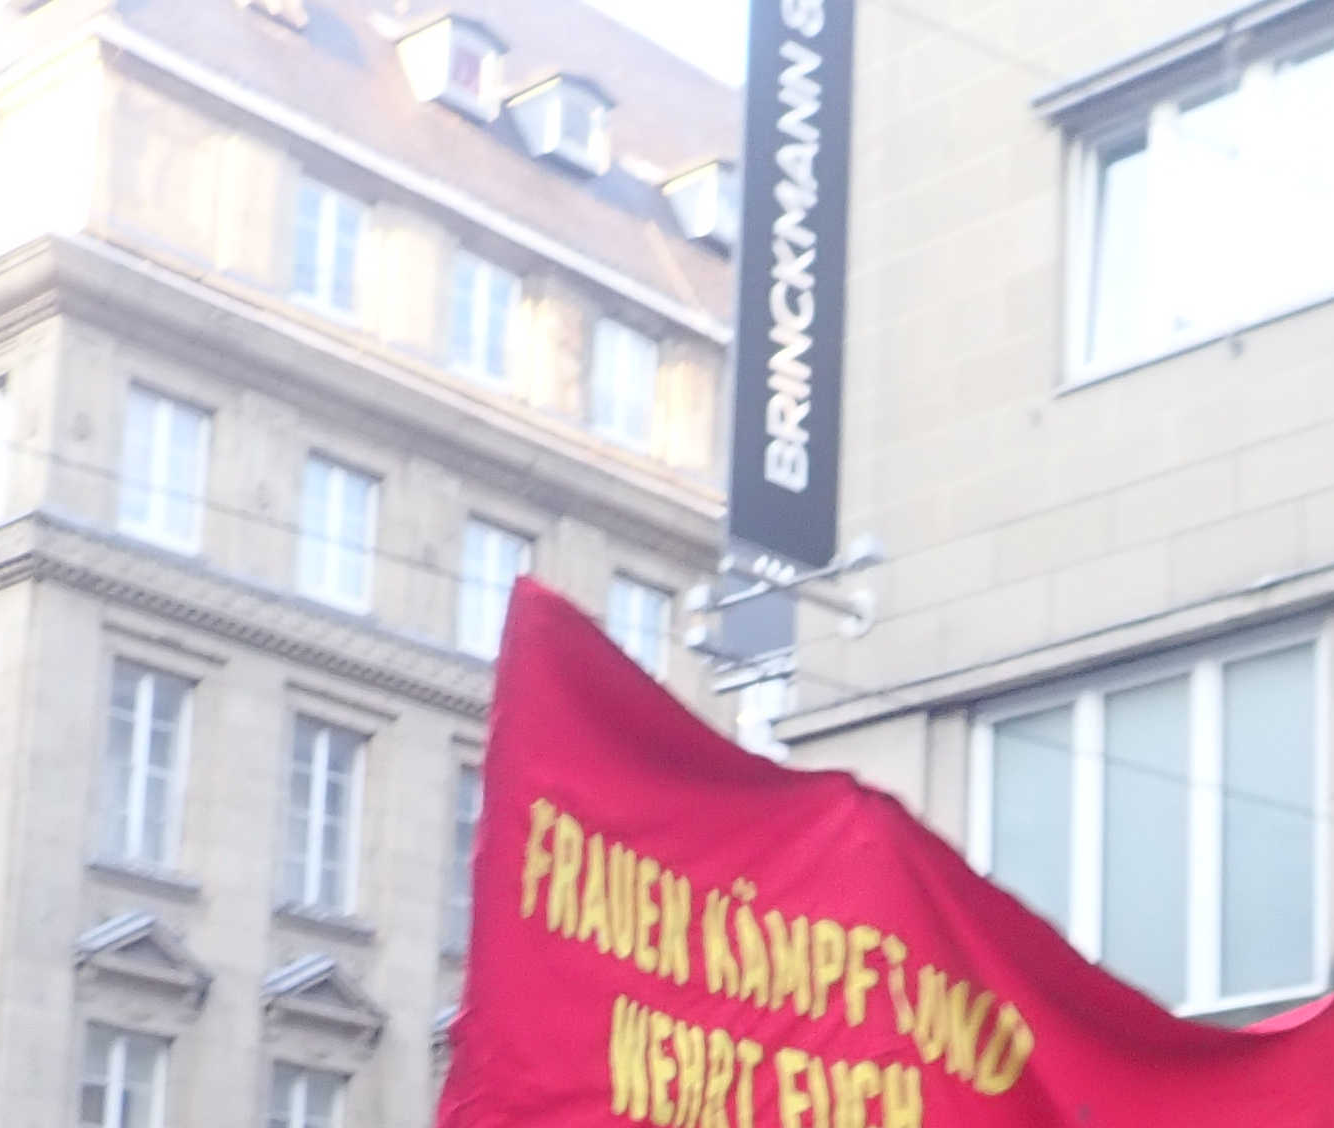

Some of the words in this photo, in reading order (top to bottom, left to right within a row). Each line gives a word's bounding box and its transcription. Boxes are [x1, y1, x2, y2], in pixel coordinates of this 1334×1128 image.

[764, 40, 823, 493] BRINCKMANN
[520, 797, 691, 987] FRAUEN
[914, 963, 1035, 1096] UND
